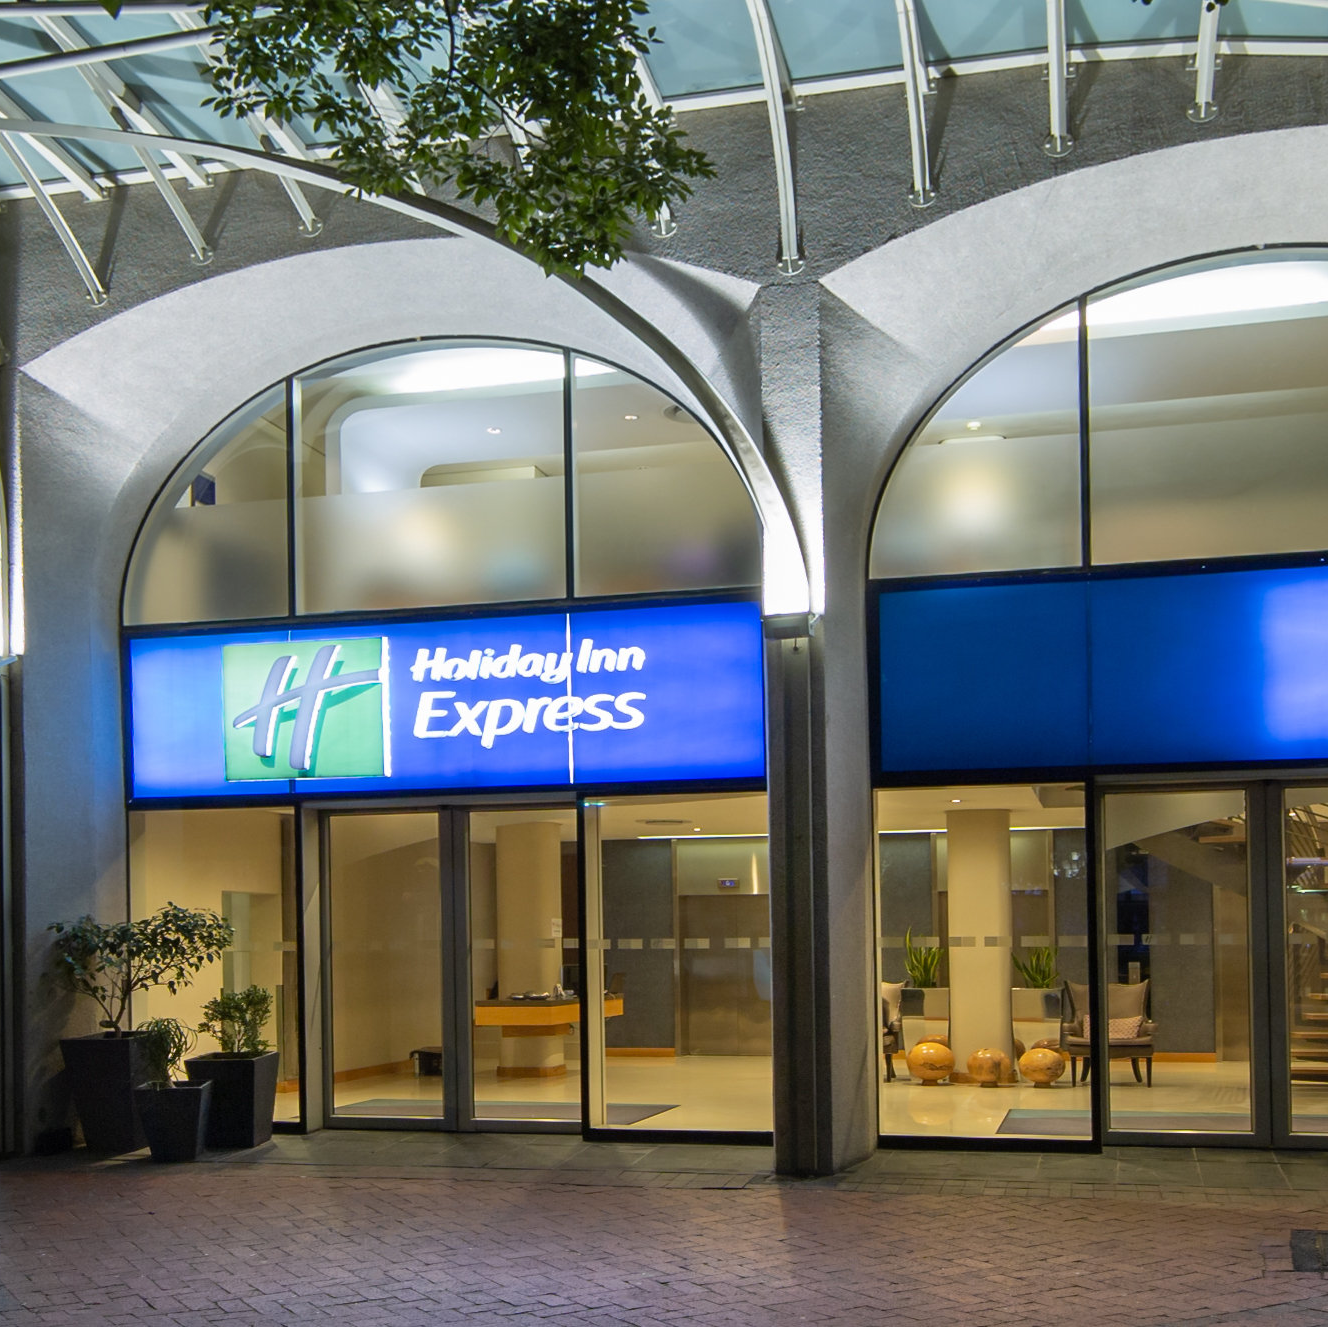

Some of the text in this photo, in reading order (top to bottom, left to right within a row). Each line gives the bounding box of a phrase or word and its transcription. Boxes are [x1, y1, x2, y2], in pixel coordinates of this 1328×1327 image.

[410, 638, 646, 684] Holiday Inn
[413, 690, 647, 749] Express
